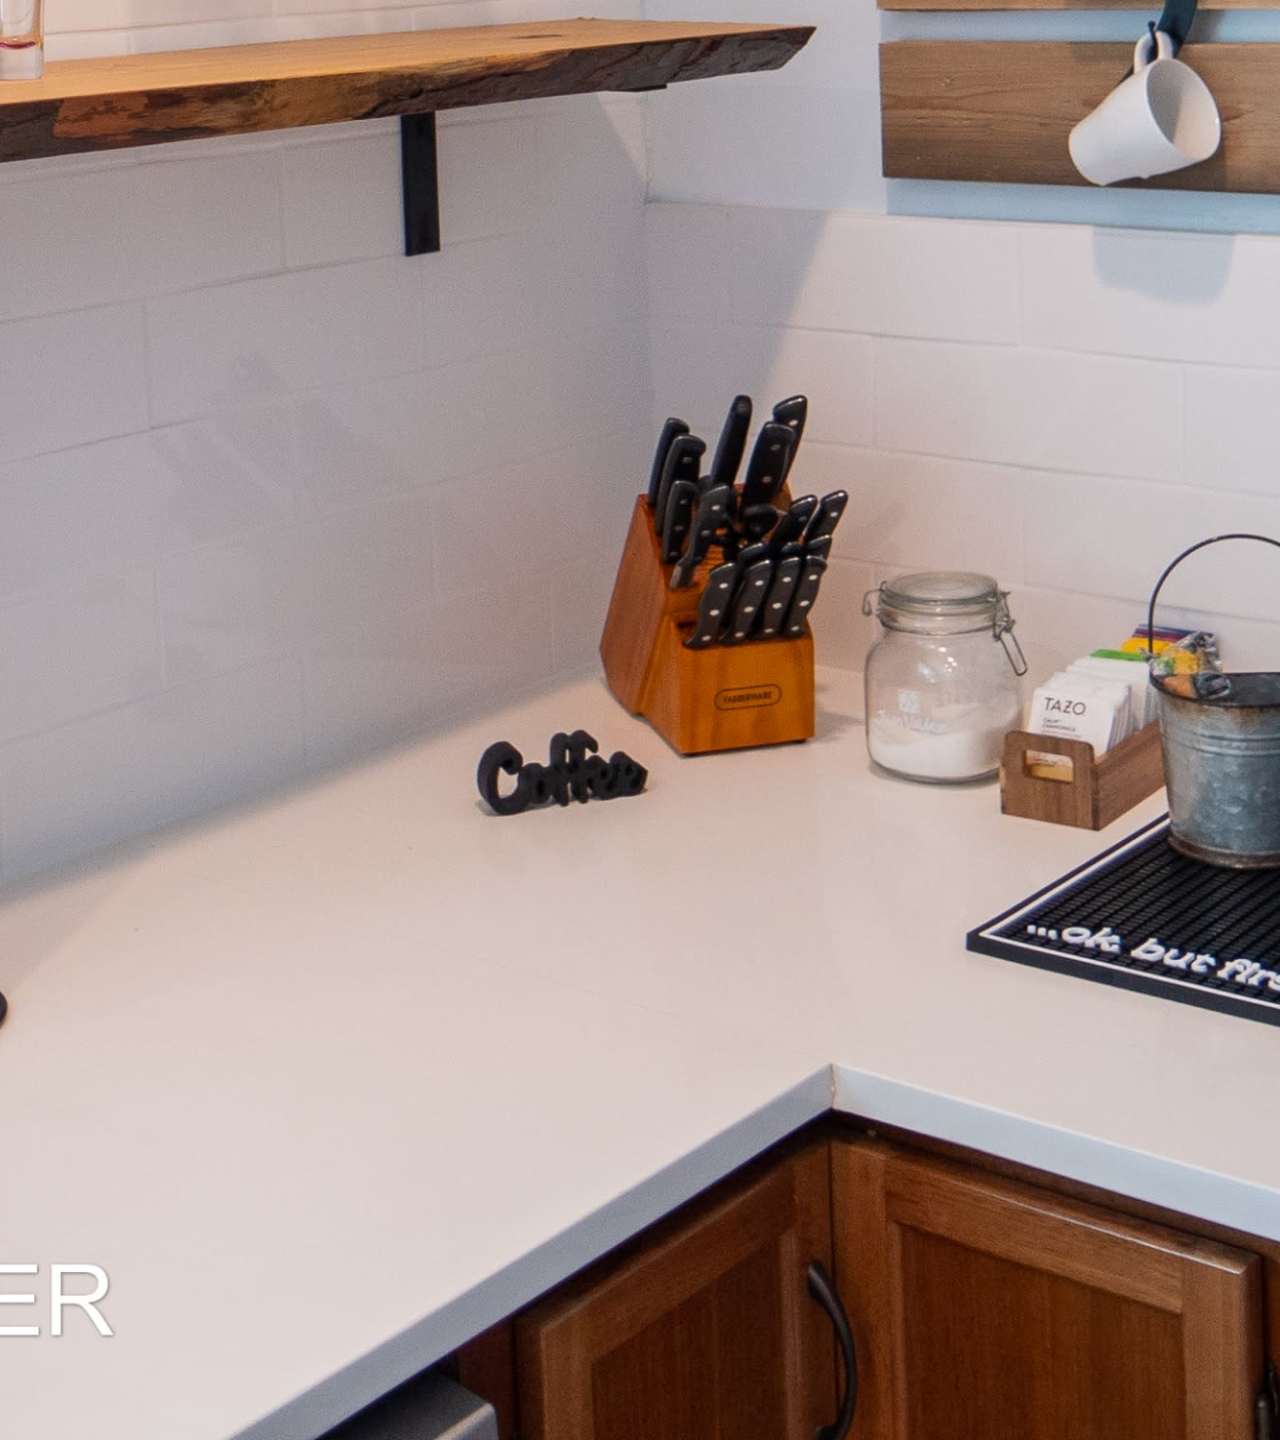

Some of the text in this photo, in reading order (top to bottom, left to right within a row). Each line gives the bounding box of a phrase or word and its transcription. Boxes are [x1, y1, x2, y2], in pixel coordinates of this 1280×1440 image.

[1044, 696, 1087, 716] TAZO
[477, 729, 649, 816] Coffee
[1131, 937, 1216, 973] but
